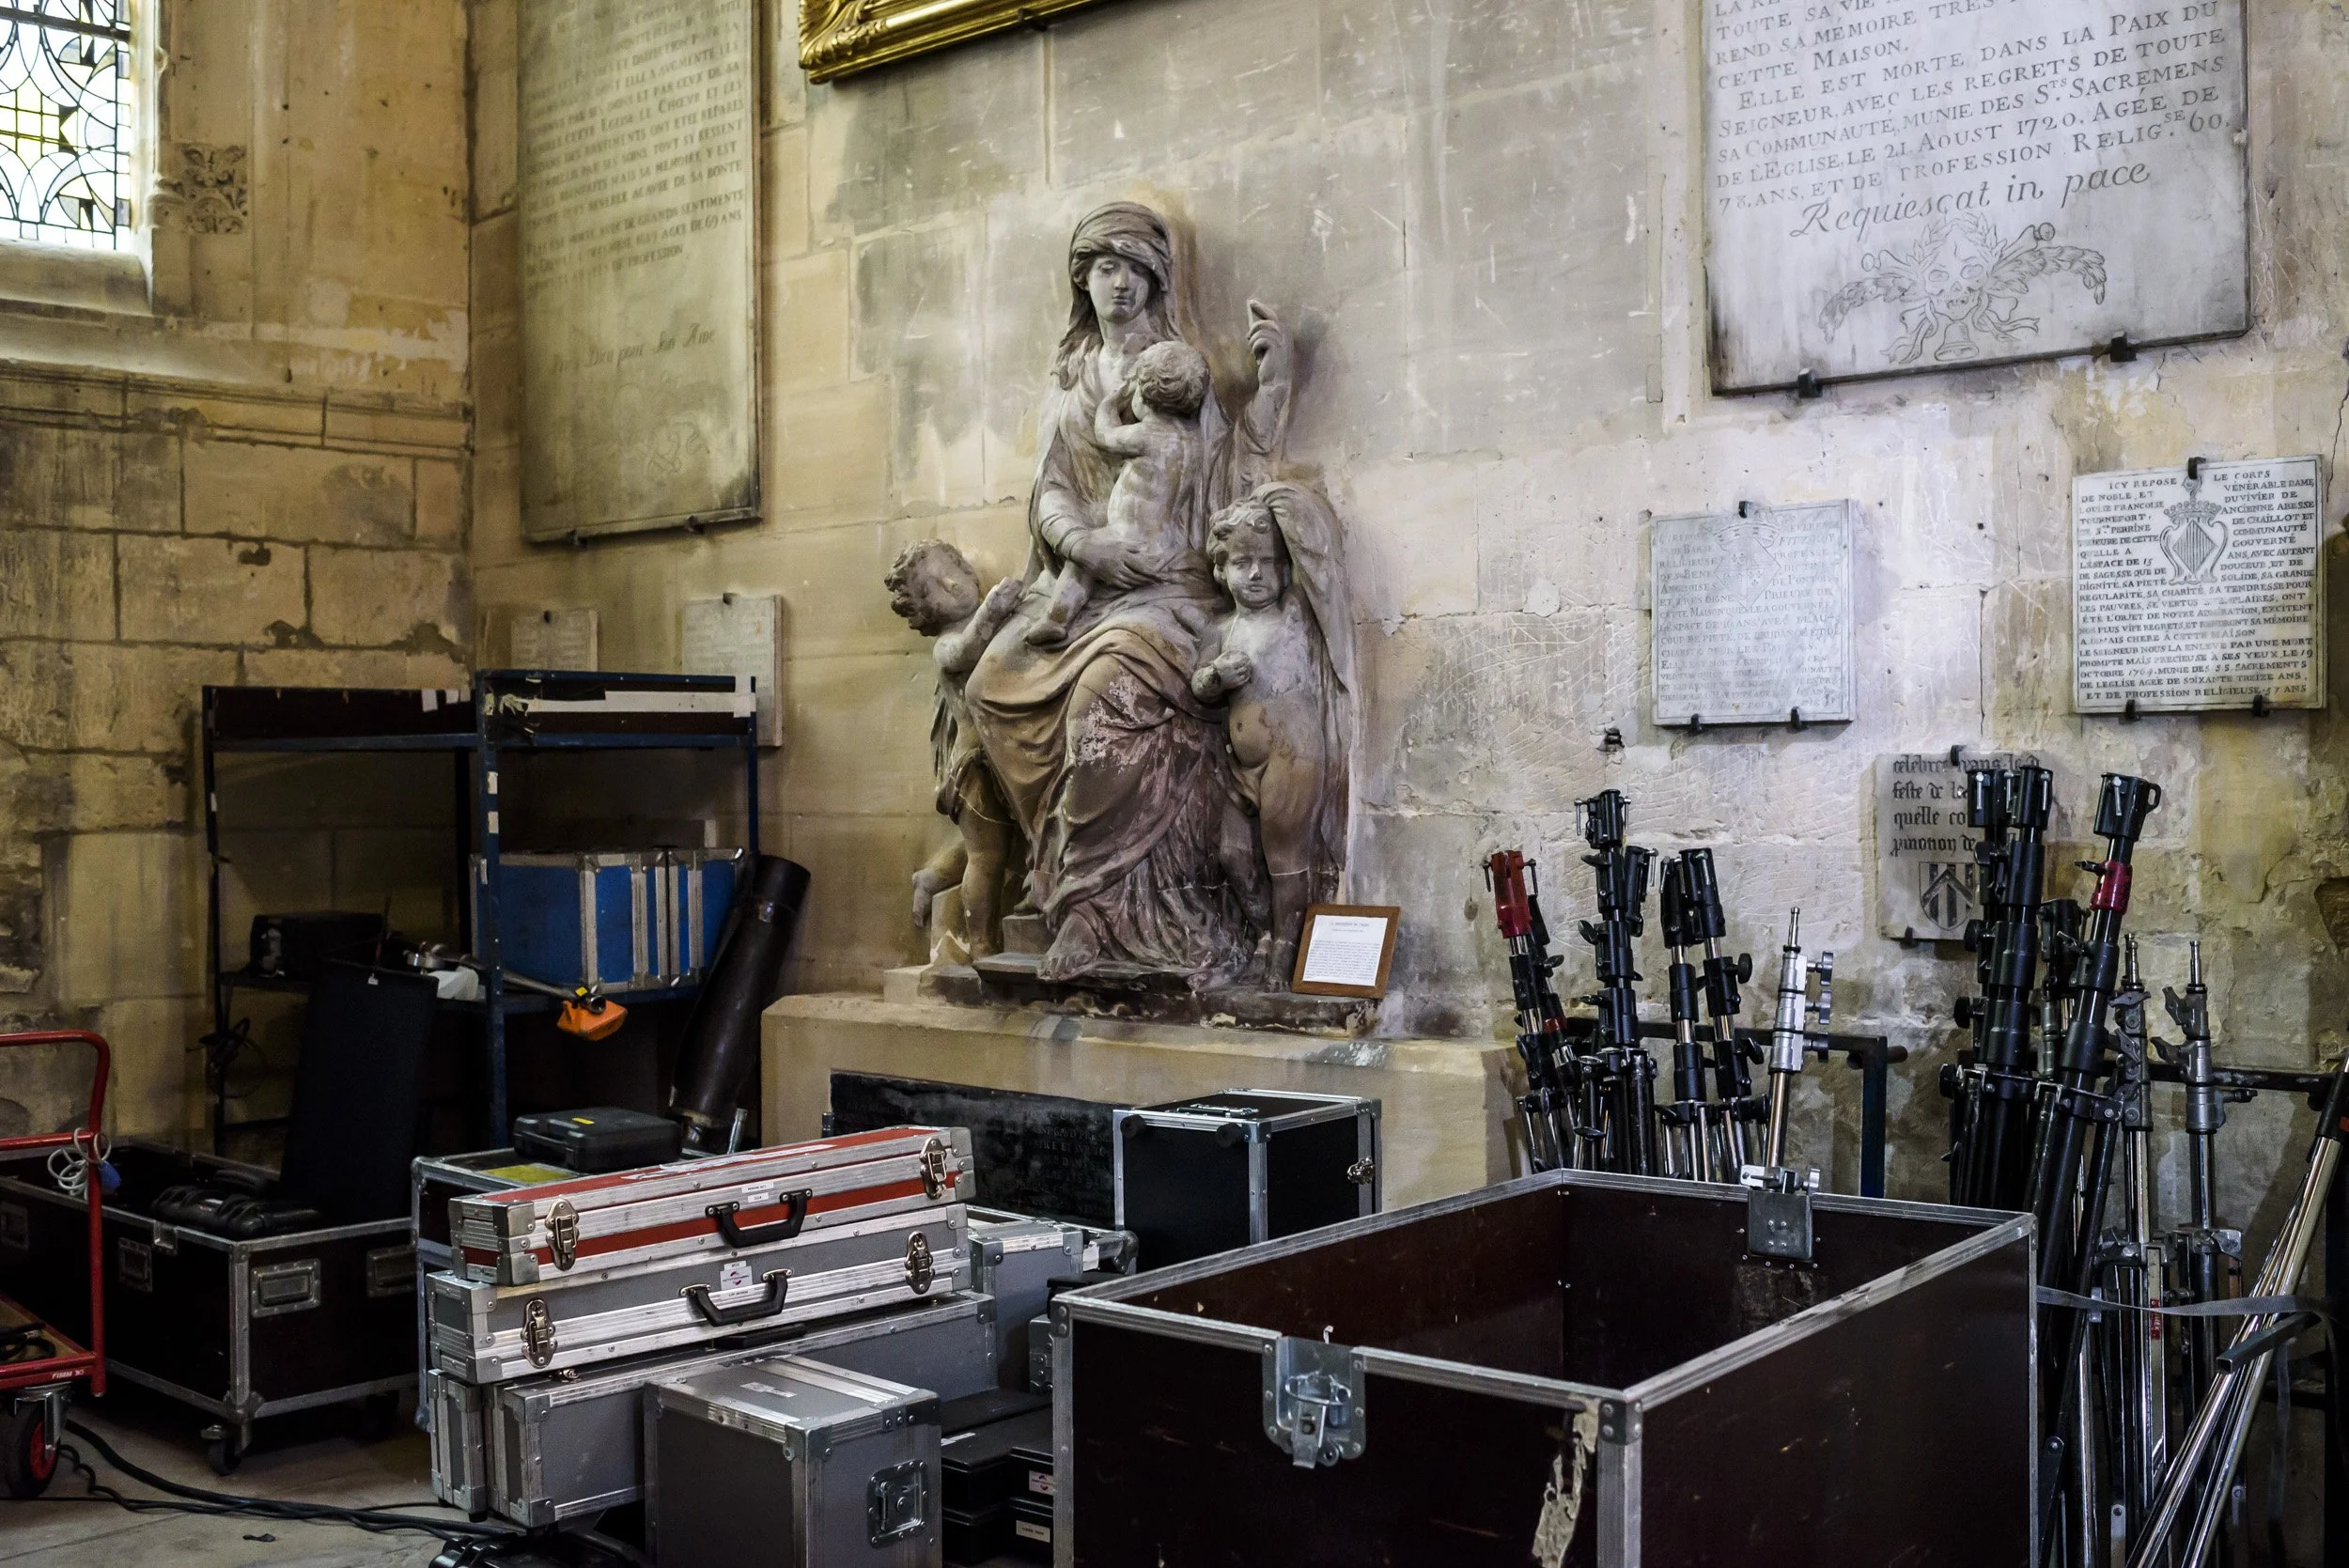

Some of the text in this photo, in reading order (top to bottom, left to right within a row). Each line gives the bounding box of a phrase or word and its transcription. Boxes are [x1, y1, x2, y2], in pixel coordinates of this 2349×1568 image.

[1717, 13, 1792, 40] TOUTE
[1804, 6, 1831, 22] SA
[1716, 42, 1771, 66] REND
[1780, 34, 1806, 53] SA
[1738, 1, 2217, 110] ELLE EST MORTE DANS LA PAIX DU
[1719, 39, 1909, 89] CETTE MAISON.
[1842, 92, 1900, 116] AVEC
[1912, 81, 1953, 101] LES
[1965, 55, 2080, 91] REGRETS
[2093, 47, 2127, 67] DE
[2136, 28, 2225, 58] TOUTE
[1719, 148, 1740, 163] SA
[1903, 102, 1973, 130] MUNIE
[1981, 94, 2024, 115] DES
[2069, 54, 2224, 99] SACREMENS
[1717, 171, 1743, 189] DE
[1847, 148, 1876, 165] LE
[1917, 124, 2003, 153] AOUST
[2182, 85, 2219, 106] DE
[1811, 179, 1844, 197] ET
[1853, 172, 1883, 190] DE
[1900, 143, 2052, 182] PROFESSION
[1789, 162, 2151, 241] Requiescat in pace
[2109, 481, 2128, 489] ICY
[2133, 477, 2177, 488] REPOSE
[2234, 470, 2270, 479] CORPS
[2132, 535, 2159, 543] CETTE
[2250, 550, 2275, 558] AVEC
[2277, 547, 2315, 556] AUTANT
[2093, 569, 2132, 579] SAGESSE
[2134, 568, 2152, 577] QUE
[2261, 571, 2273, 580] SA
[2276, 569, 2315, 579] GRANDE
[2147, 590, 2159, 598] SA
[2224, 582, 2284, 593] TENDRESSE
[2286, 581, 2312, 589] POUR
[2162, 599, 2199, 608] VERTUS
[2162, 611, 2195, 619] NOTRE
[2262, 603, 2315, 613] EXCITENT
[2126, 635, 2160, 644] CHERE
[2140, 645, 2166, 654] NOUS
[2126, 656, 2151, 664] MAIS
[2080, 670, 2123, 678] OCTOBRE
[2125, 688, 2190, 698] PROFESSION
[2283, 685, 2307, 693] ANS
